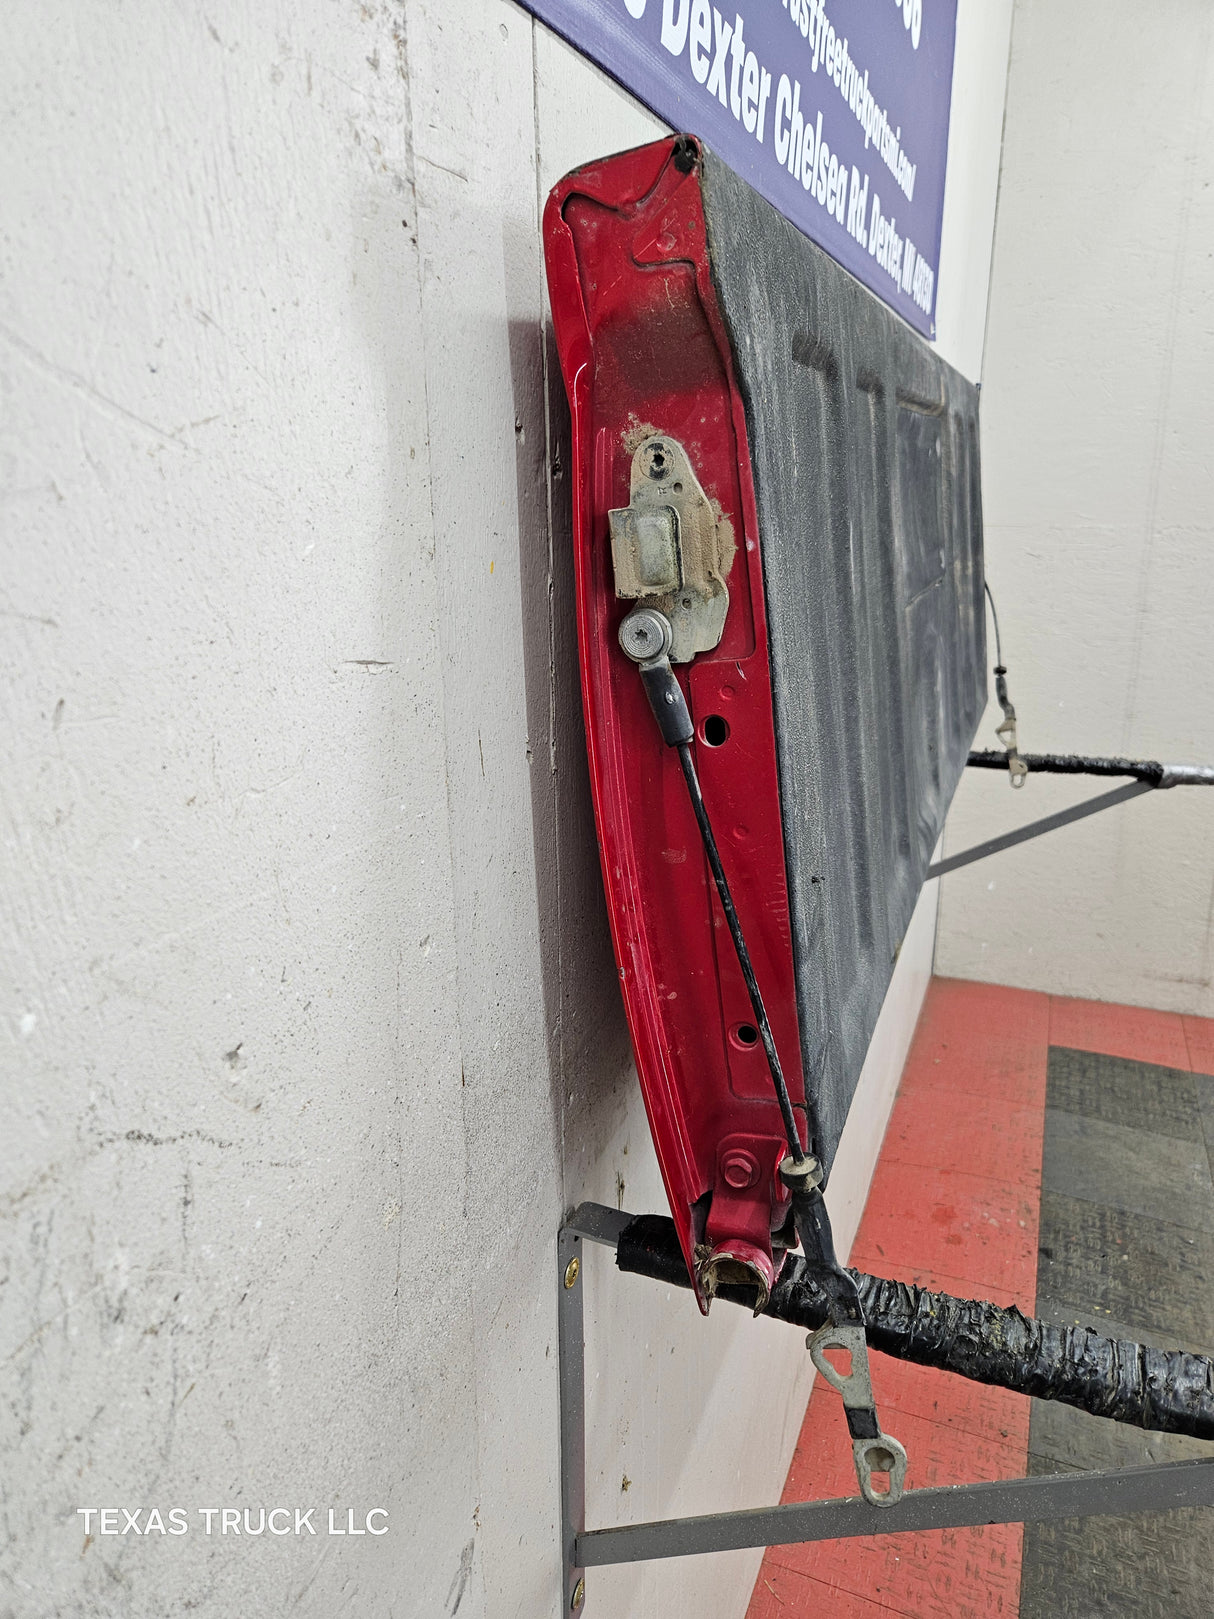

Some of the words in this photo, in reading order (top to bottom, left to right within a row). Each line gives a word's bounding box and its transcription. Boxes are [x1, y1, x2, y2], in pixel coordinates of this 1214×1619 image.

[775, 74, 848, 226] Chelsea
[847, 164, 870, 249] Rd.
[868, 193, 904, 294] Dexter,
[902, 237, 917, 296] MI
